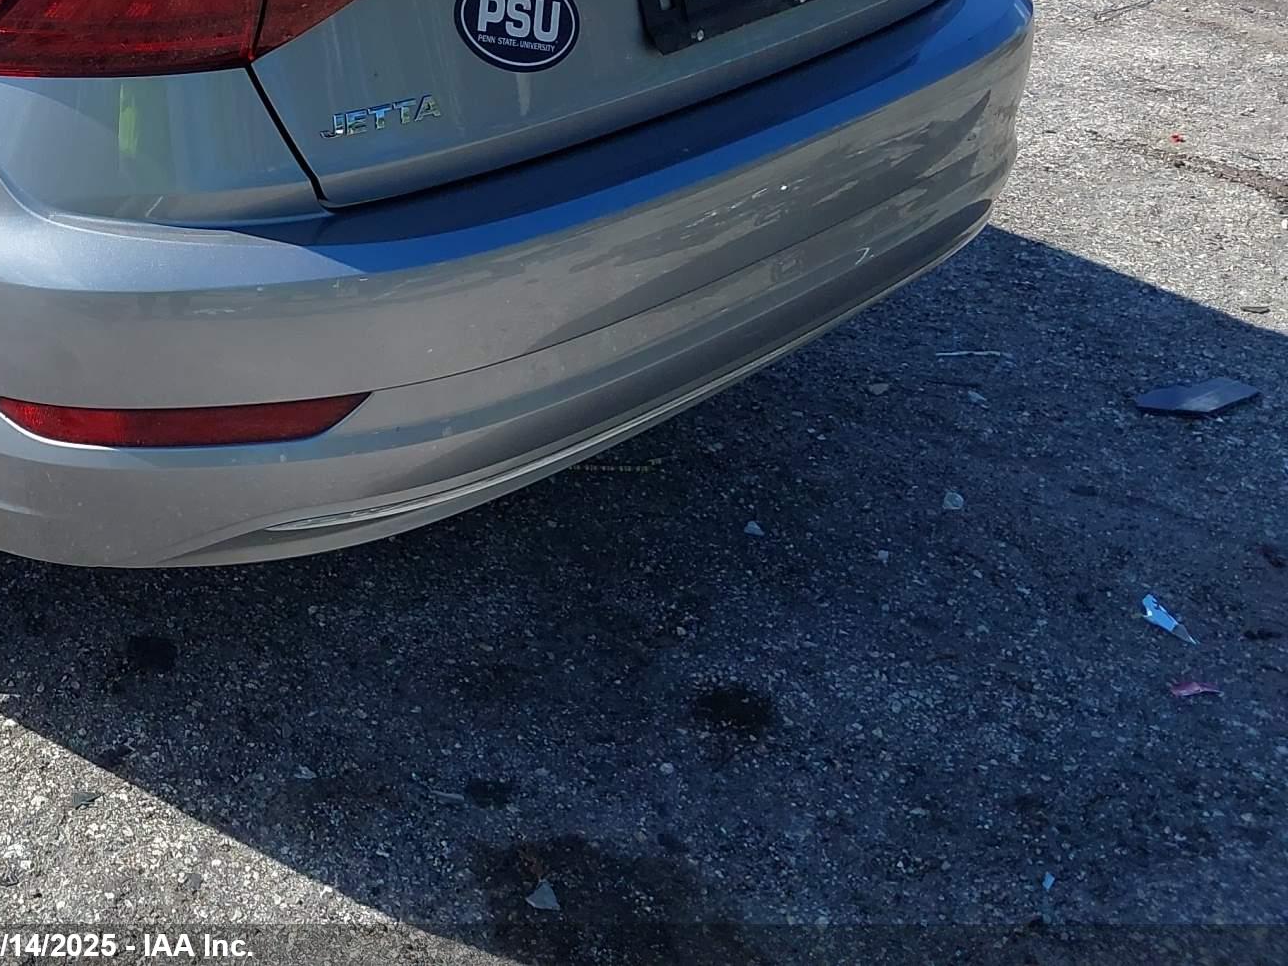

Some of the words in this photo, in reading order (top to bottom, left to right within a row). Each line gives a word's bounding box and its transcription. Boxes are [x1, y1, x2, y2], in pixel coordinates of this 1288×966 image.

[477, 33, 496, 44] PENN
[497, 37, 518, 47] STATE
[519, 40, 556, 53] UNIVERSITY
[320, 94, 442, 140] JETTA
